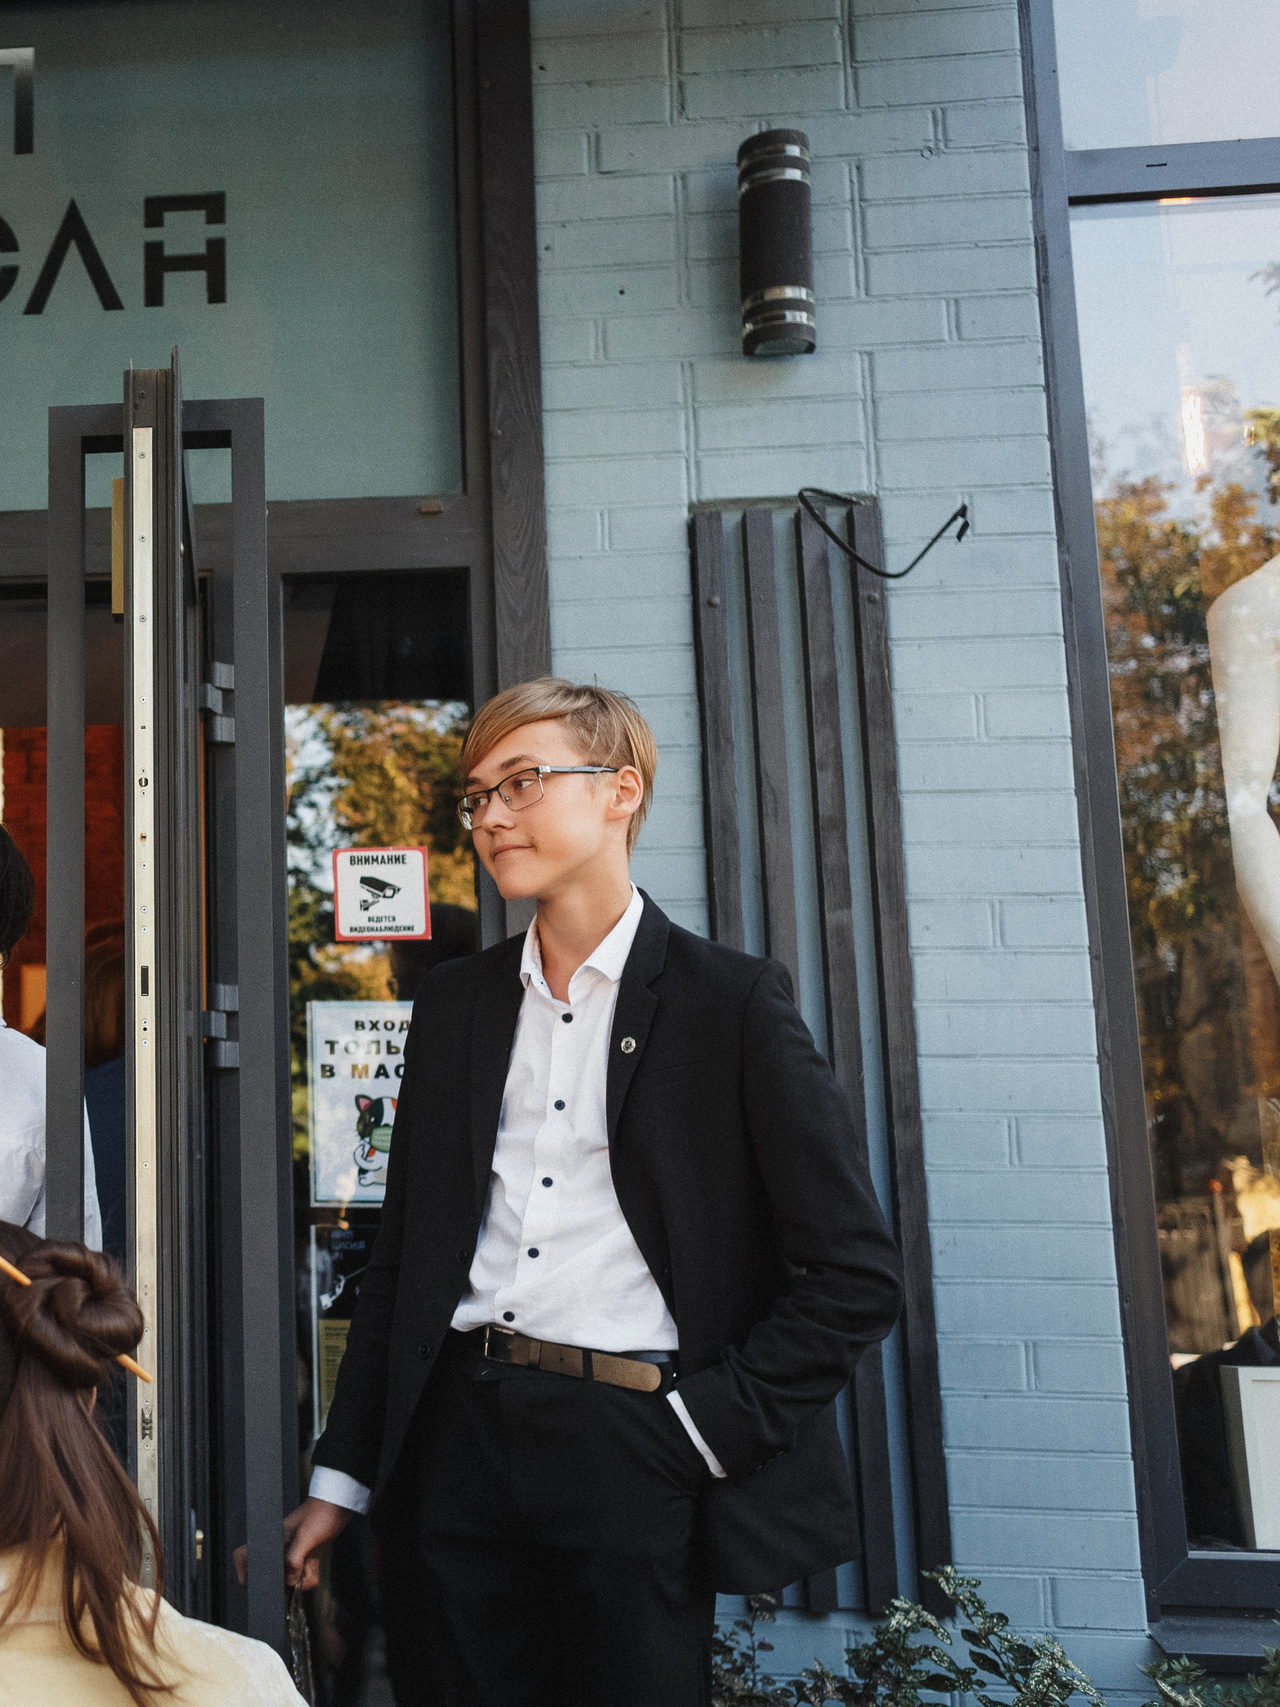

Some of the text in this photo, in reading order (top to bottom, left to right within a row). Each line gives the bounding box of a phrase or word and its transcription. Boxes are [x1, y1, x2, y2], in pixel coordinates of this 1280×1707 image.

[349, 854, 408, 866] ВНИМАНИЕ
[367, 915, 396, 924] ВЕДЕТСЯ
[349, 925, 415, 934] ВИДЕОНАБЛЮДЕНИЕ
[320, 1063, 336, 1079] В
